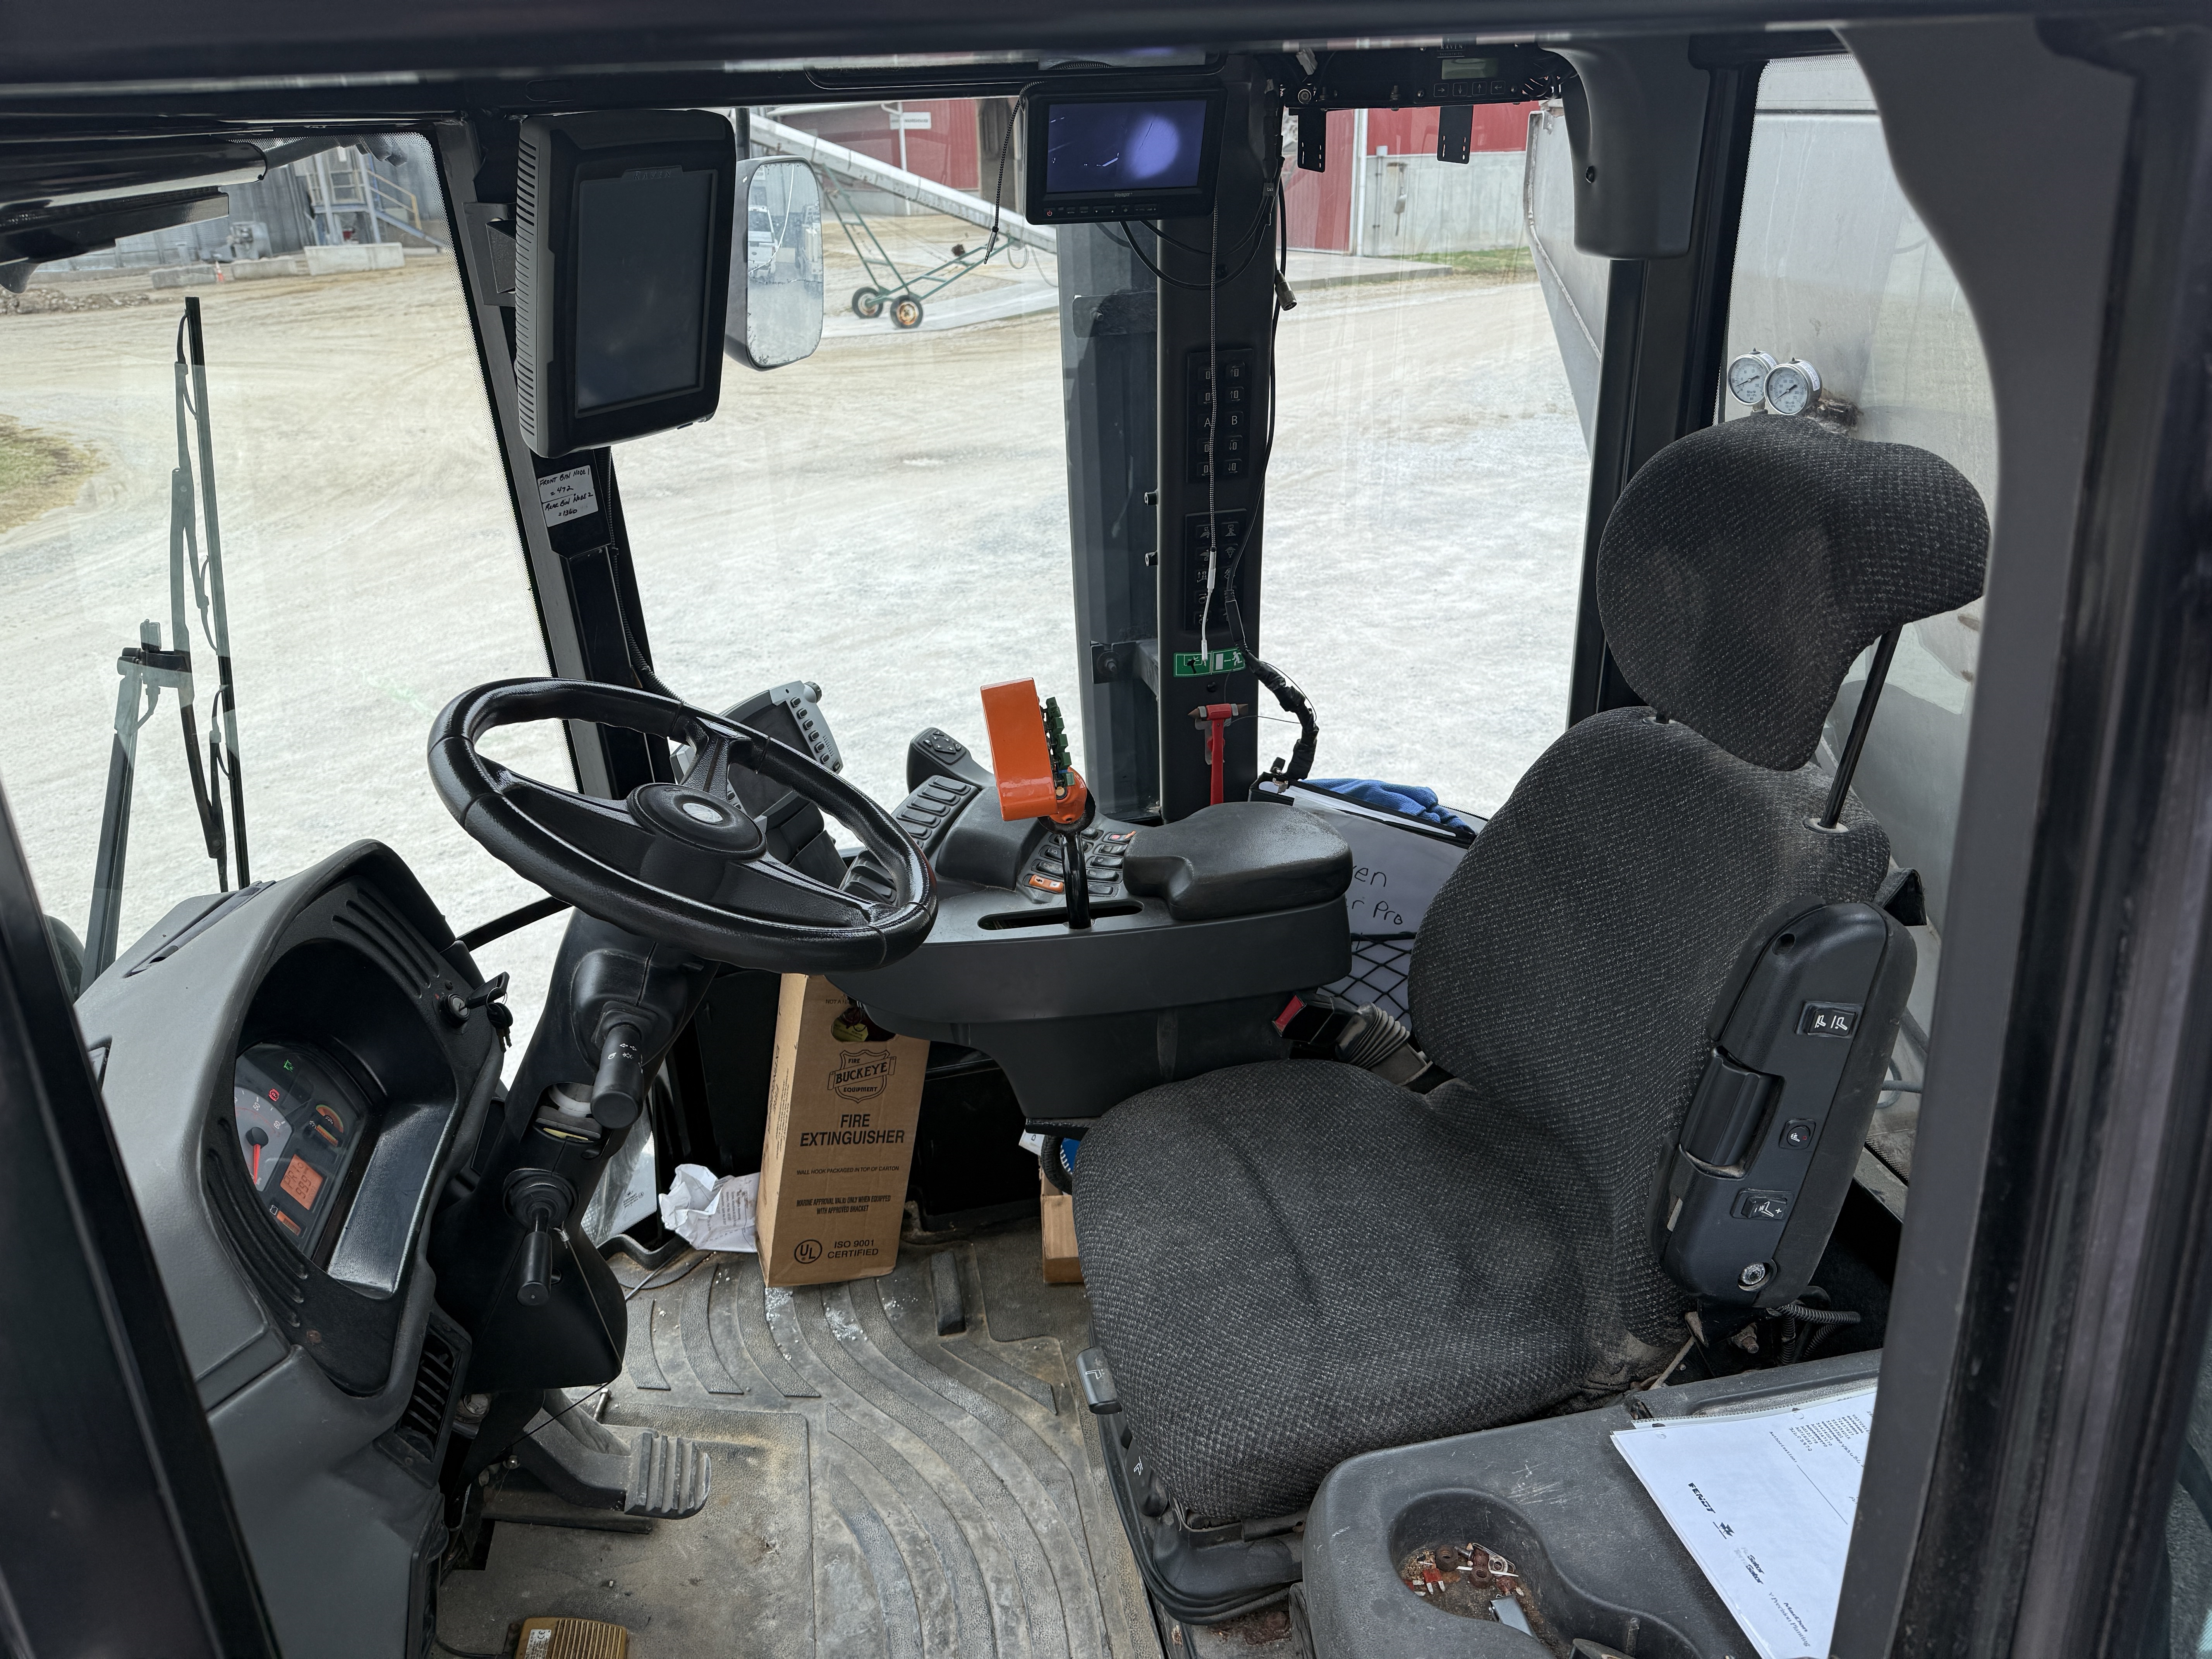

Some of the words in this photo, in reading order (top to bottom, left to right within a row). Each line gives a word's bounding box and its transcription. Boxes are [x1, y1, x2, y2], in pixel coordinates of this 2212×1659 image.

[1204, 417, 1211, 427] A
[1231, 415, 1238, 426] B
[539, 477, 558, 487] FRONT
[559, 472, 571, 481] BIN
[573, 469, 586, 477] NODE
[1352, 864, 1388, 888] en
[1372, 900, 1403, 926] Pro
[835, 1061, 888, 1085] BUCKEYE
[253, 1102, 261, 1111] 50
[273, 1120, 281, 1129] 60
[840, 1114, 871, 1128] FIRE
[799, 1129, 905, 1147] EXTINGUISHER
[796, 1199, 813, 1207] MARINE
[813, 1197, 835, 1206] APPROVAL
[850, 1205, 869, 1213] BRACKET
[854, 1239, 874, 1247] 9001
[799, 1243, 816, 1259] UL
[827, 1248, 879, 1259] CERTIFIED
[1687, 1482, 1716, 1515] FENDT
[1771, 1597, 1792, 1623] Precision
[1790, 1622, 1811, 1647] Planting
